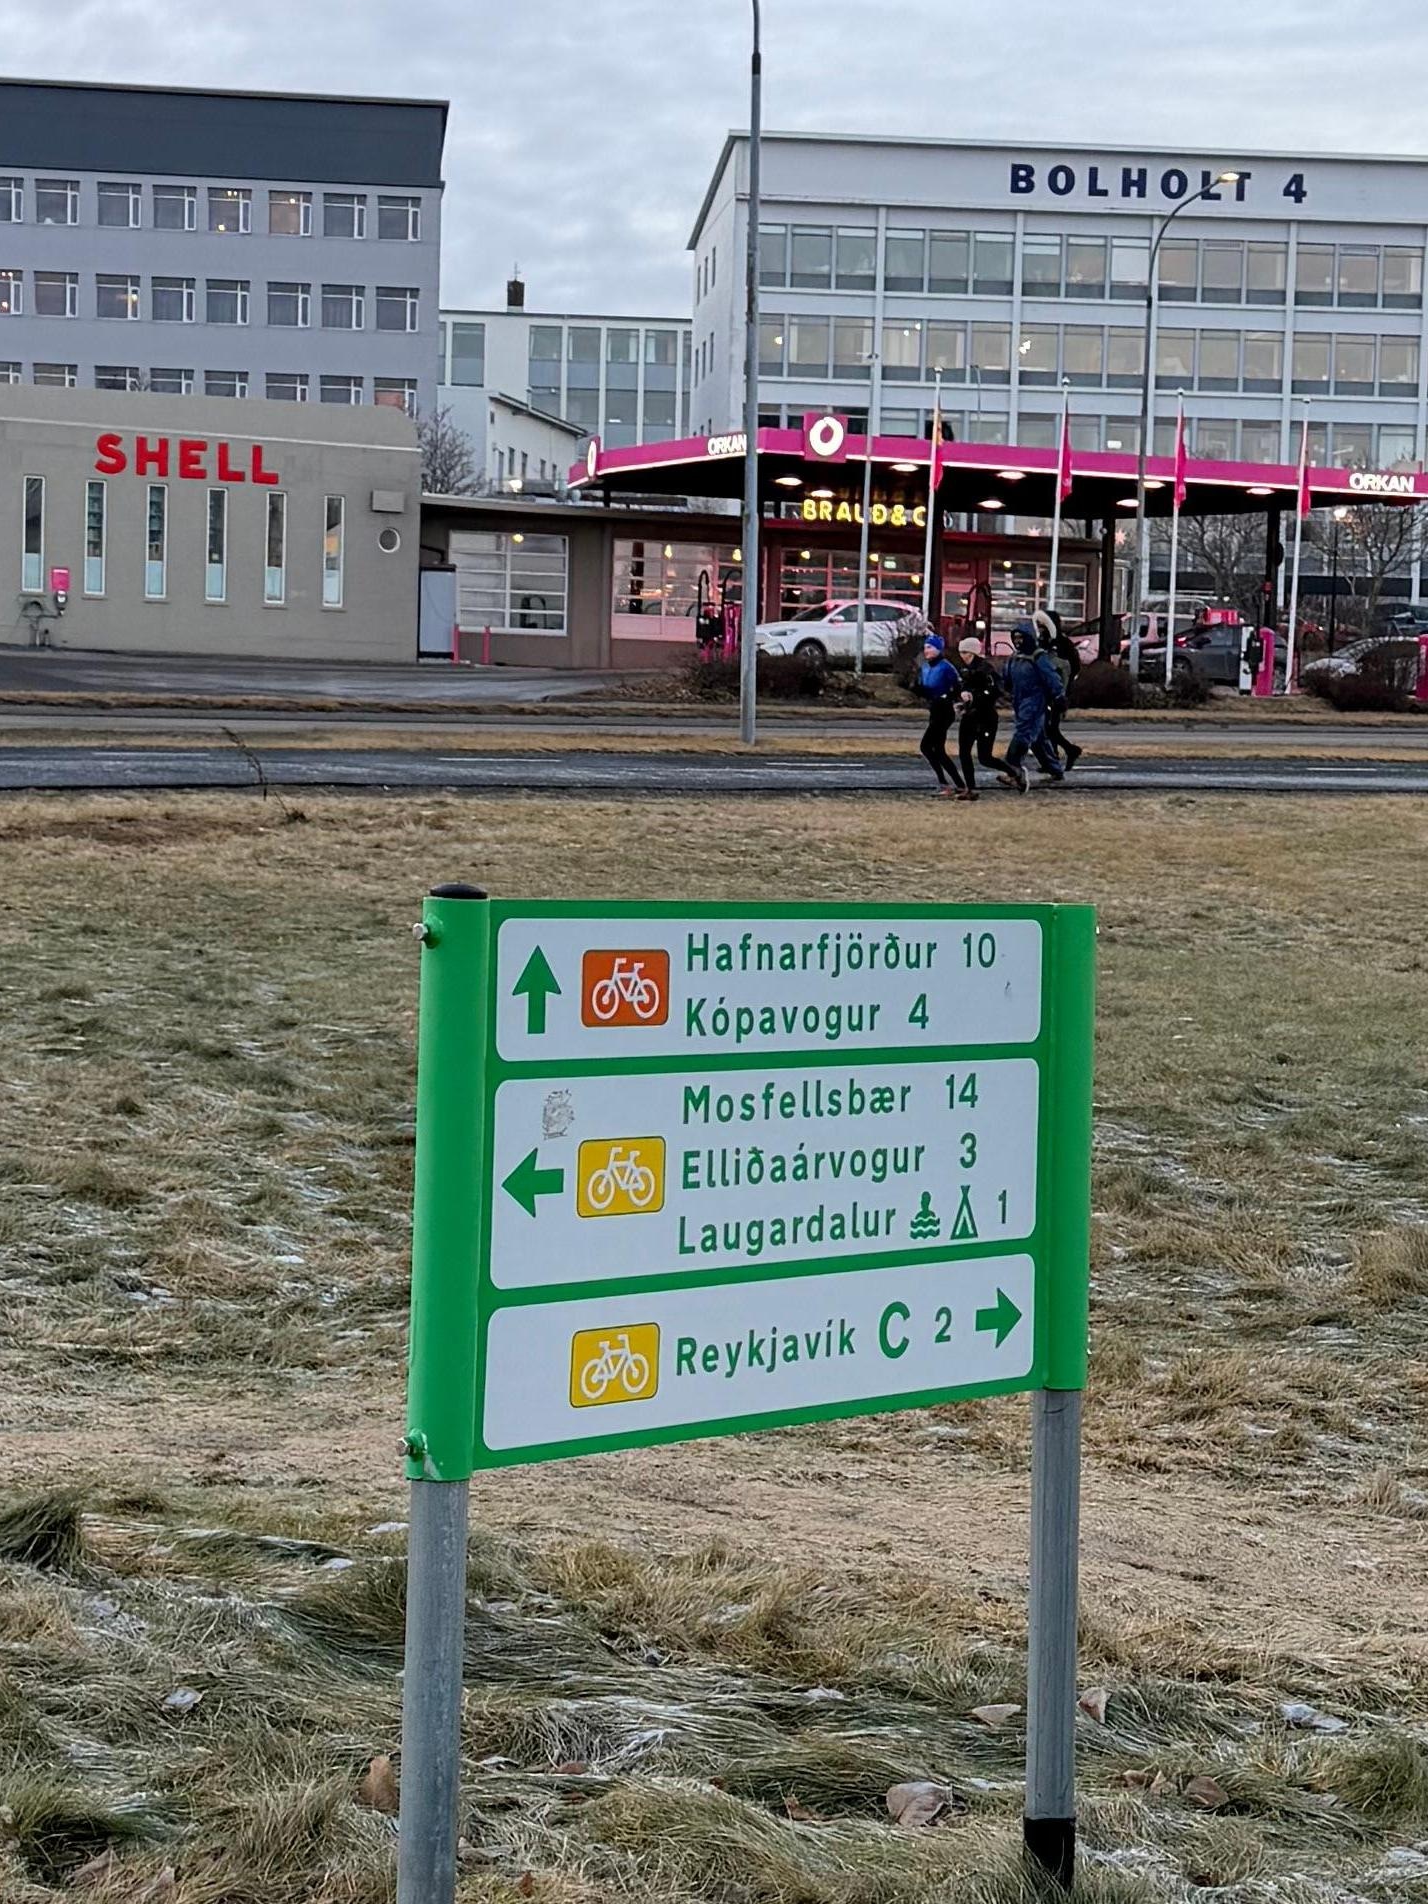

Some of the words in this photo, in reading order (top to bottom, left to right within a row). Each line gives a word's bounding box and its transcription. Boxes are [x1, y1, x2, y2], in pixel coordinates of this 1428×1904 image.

[1010, 163, 1251, 202] BOLHOLT
[1283, 173, 1308, 204] 4
[94, 433, 280, 485] SHELL
[707, 434, 748, 456] ORKAN
[1349, 473, 1415, 492] ORKAN
[686, 932, 938, 976] Hafnarfjörður
[962, 933, 997, 969] 10
[686, 996, 881, 1044] Kópavogur
[908, 993, 930, 1030] 4
[683, 1079, 912, 1125] Mosfellsbær
[945, 1073, 979, 1111] 14
[682, 1142, 926, 1190] Elliðaárvogur
[960, 1132, 978, 1169] 3
[678, 1204, 897, 1256] Laugardalur
[998, 1190, 1009, 1226] 1
[676, 1317, 857, 1379] Reykjavík
[878, 1300, 912, 1360] C
[935, 1306, 953, 1345] 2
